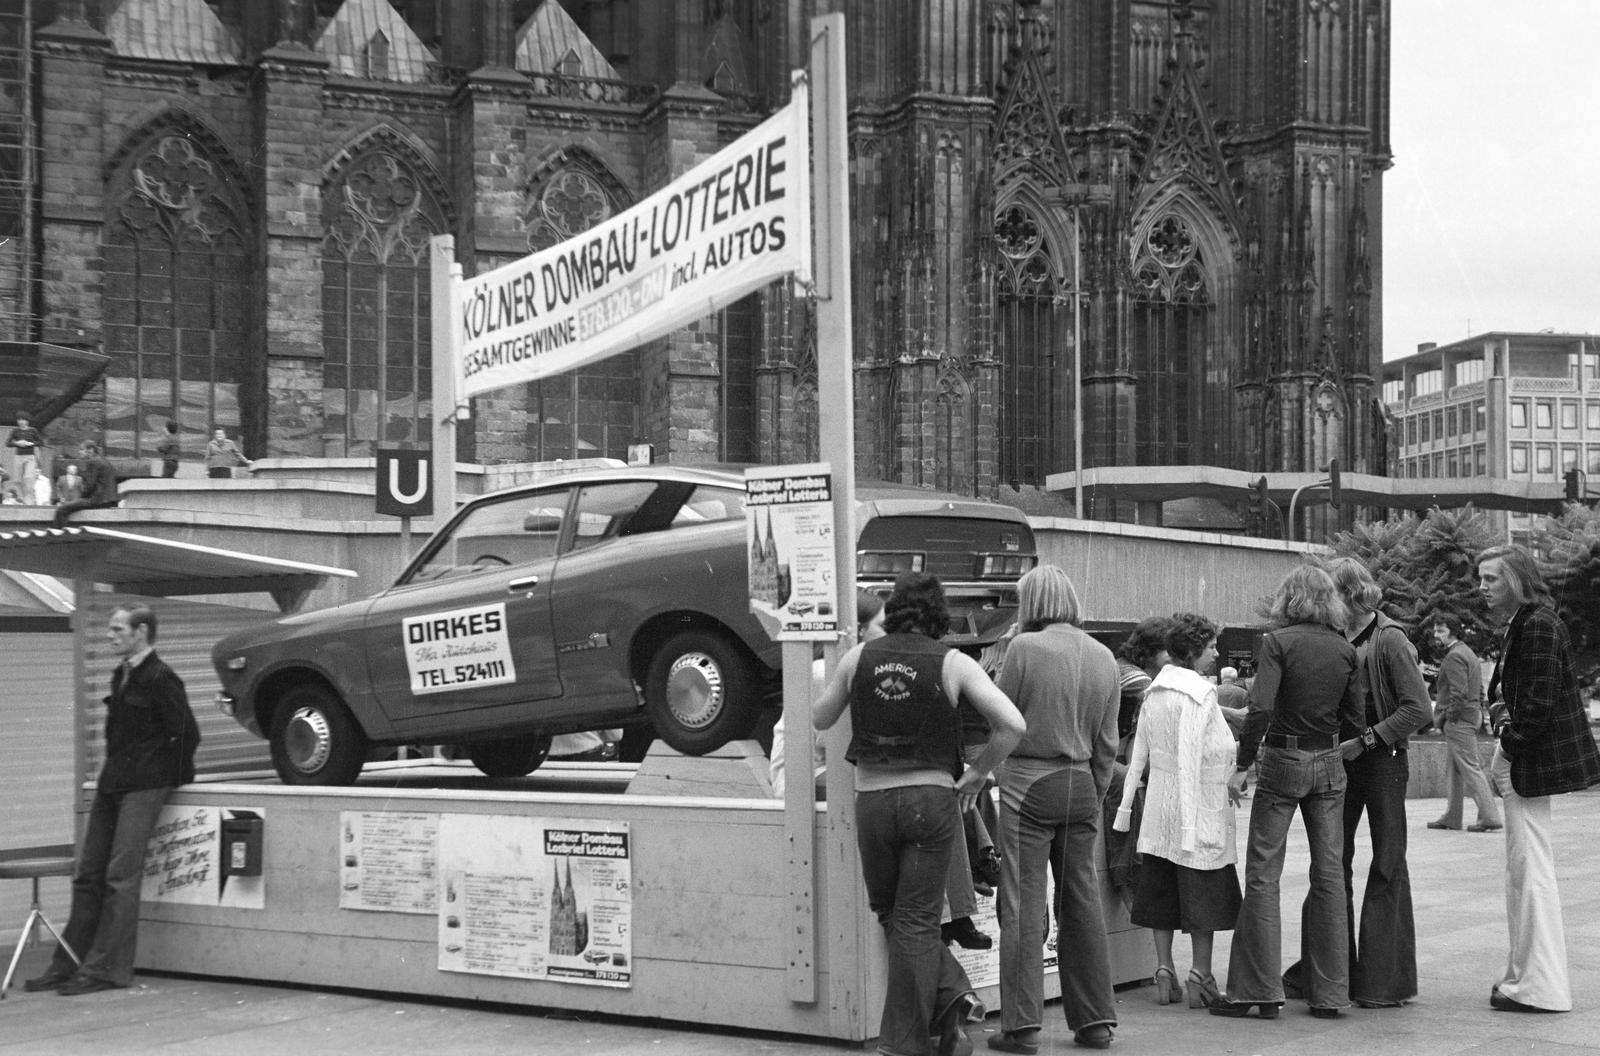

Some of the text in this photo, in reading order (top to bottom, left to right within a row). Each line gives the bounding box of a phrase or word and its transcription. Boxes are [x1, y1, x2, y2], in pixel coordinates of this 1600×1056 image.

[463, 135, 786, 343] KÖLNER DOMBAU-LOTTERIE
[670, 251, 698, 292] incl.
[703, 216, 786, 275] AUTOS
[389, 458, 428, 504] U
[408, 610, 501, 644] DIRKES
[874, 662, 918, 681] AMERICA
